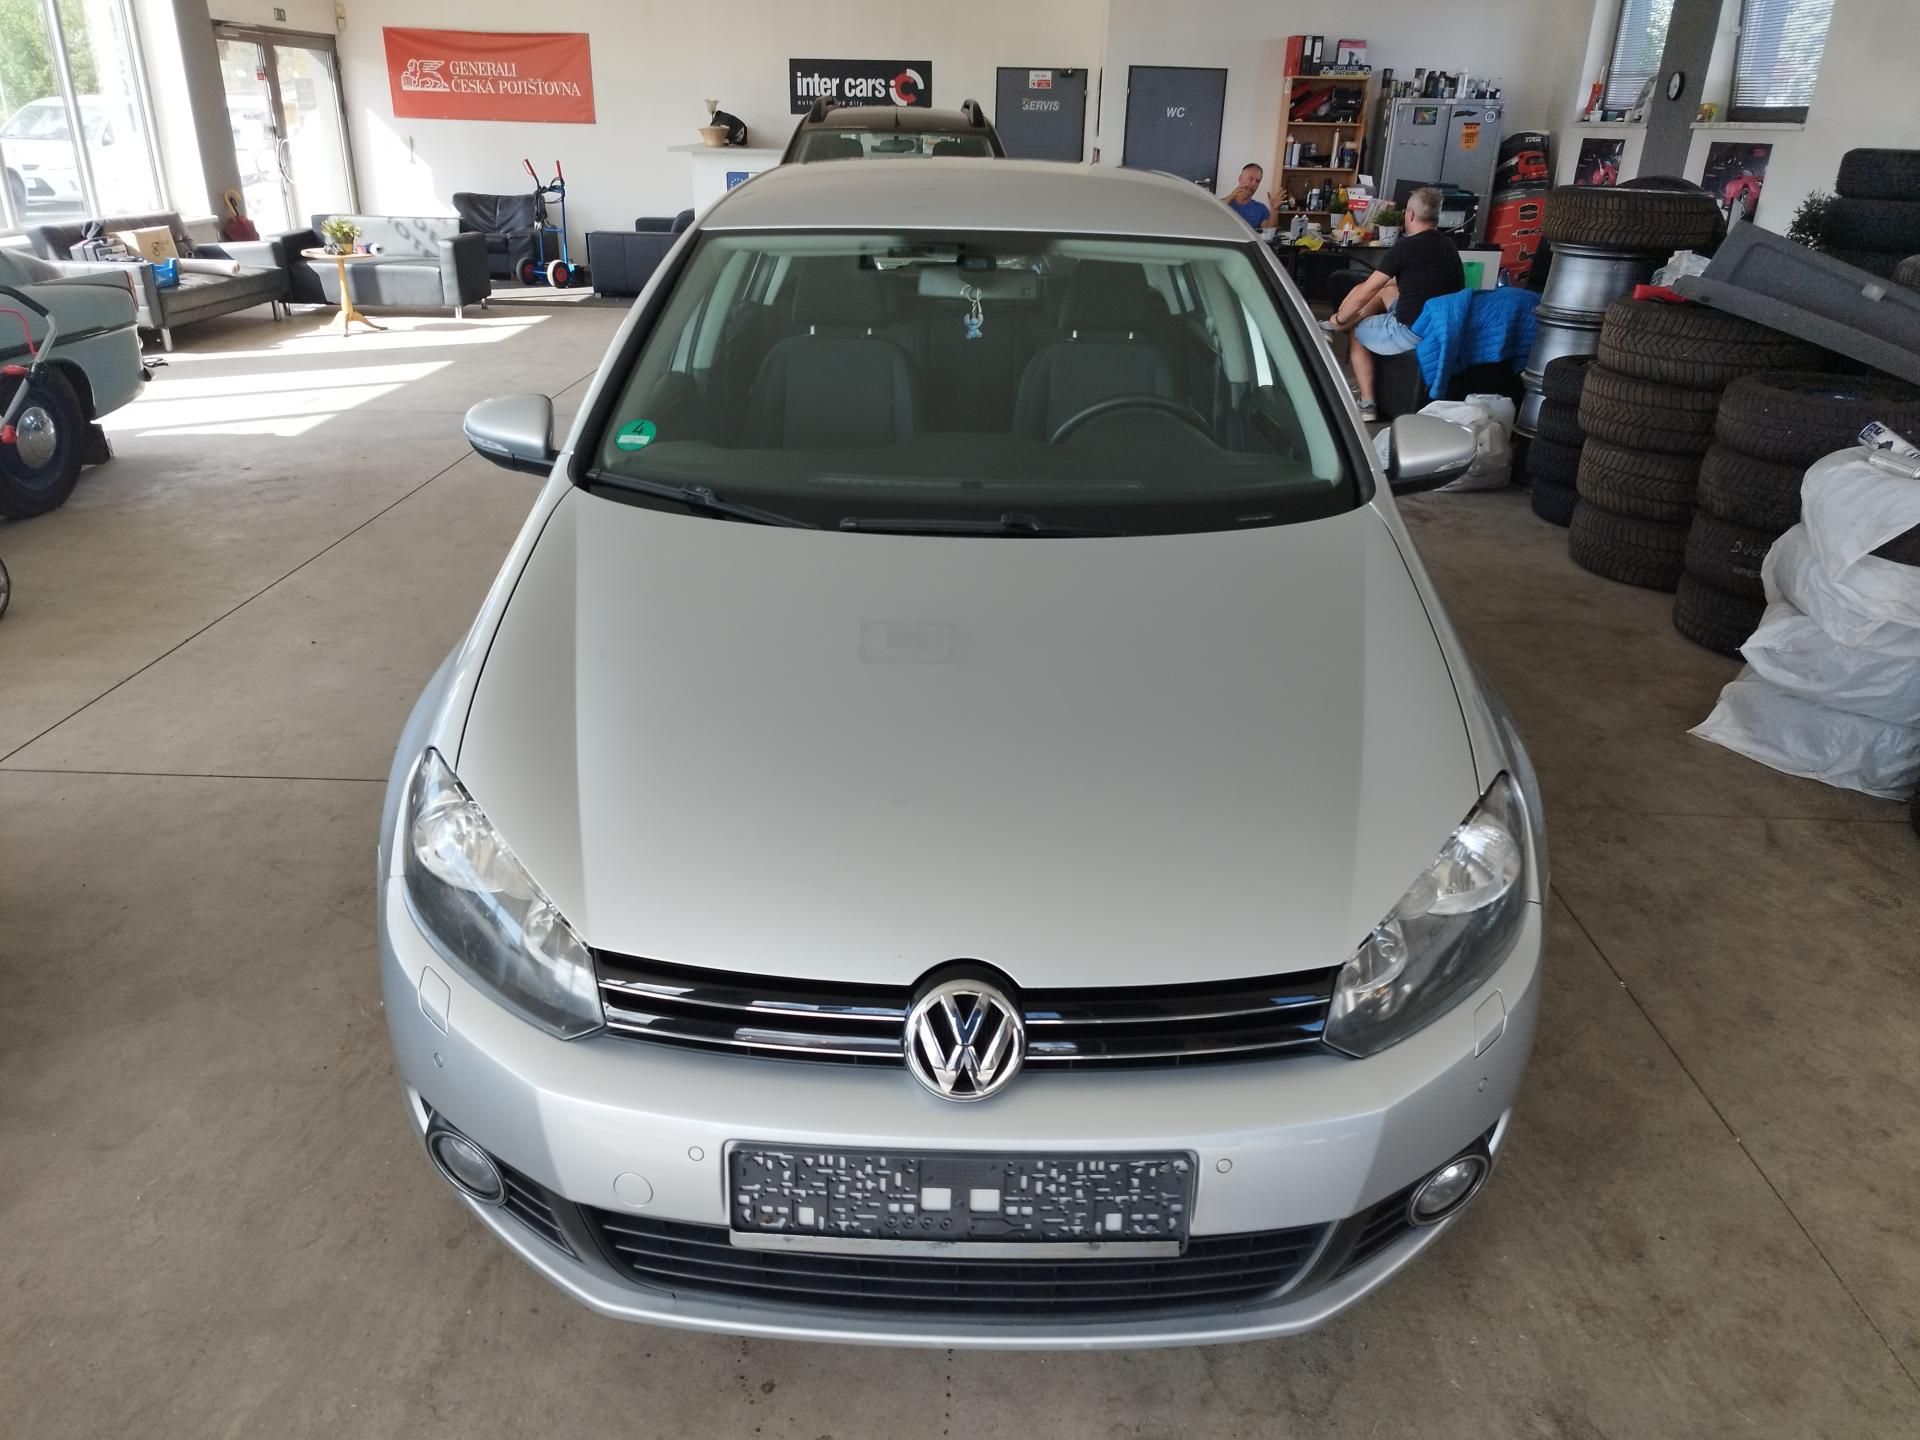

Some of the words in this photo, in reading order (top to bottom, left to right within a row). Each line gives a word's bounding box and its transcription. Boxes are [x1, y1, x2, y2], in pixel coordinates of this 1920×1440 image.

[450, 61, 517, 77] GENERALI
[451, 76, 495, 94] ČESKÁ
[499, 78, 582, 97] POJIŠŤOVNA
[796, 71, 840, 97] inter
[844, 77, 886, 98] cars
[1022, 100, 1060, 111] SERVIS
[1166, 106, 1187, 118] WC
[631, 420, 645, 436] 4
